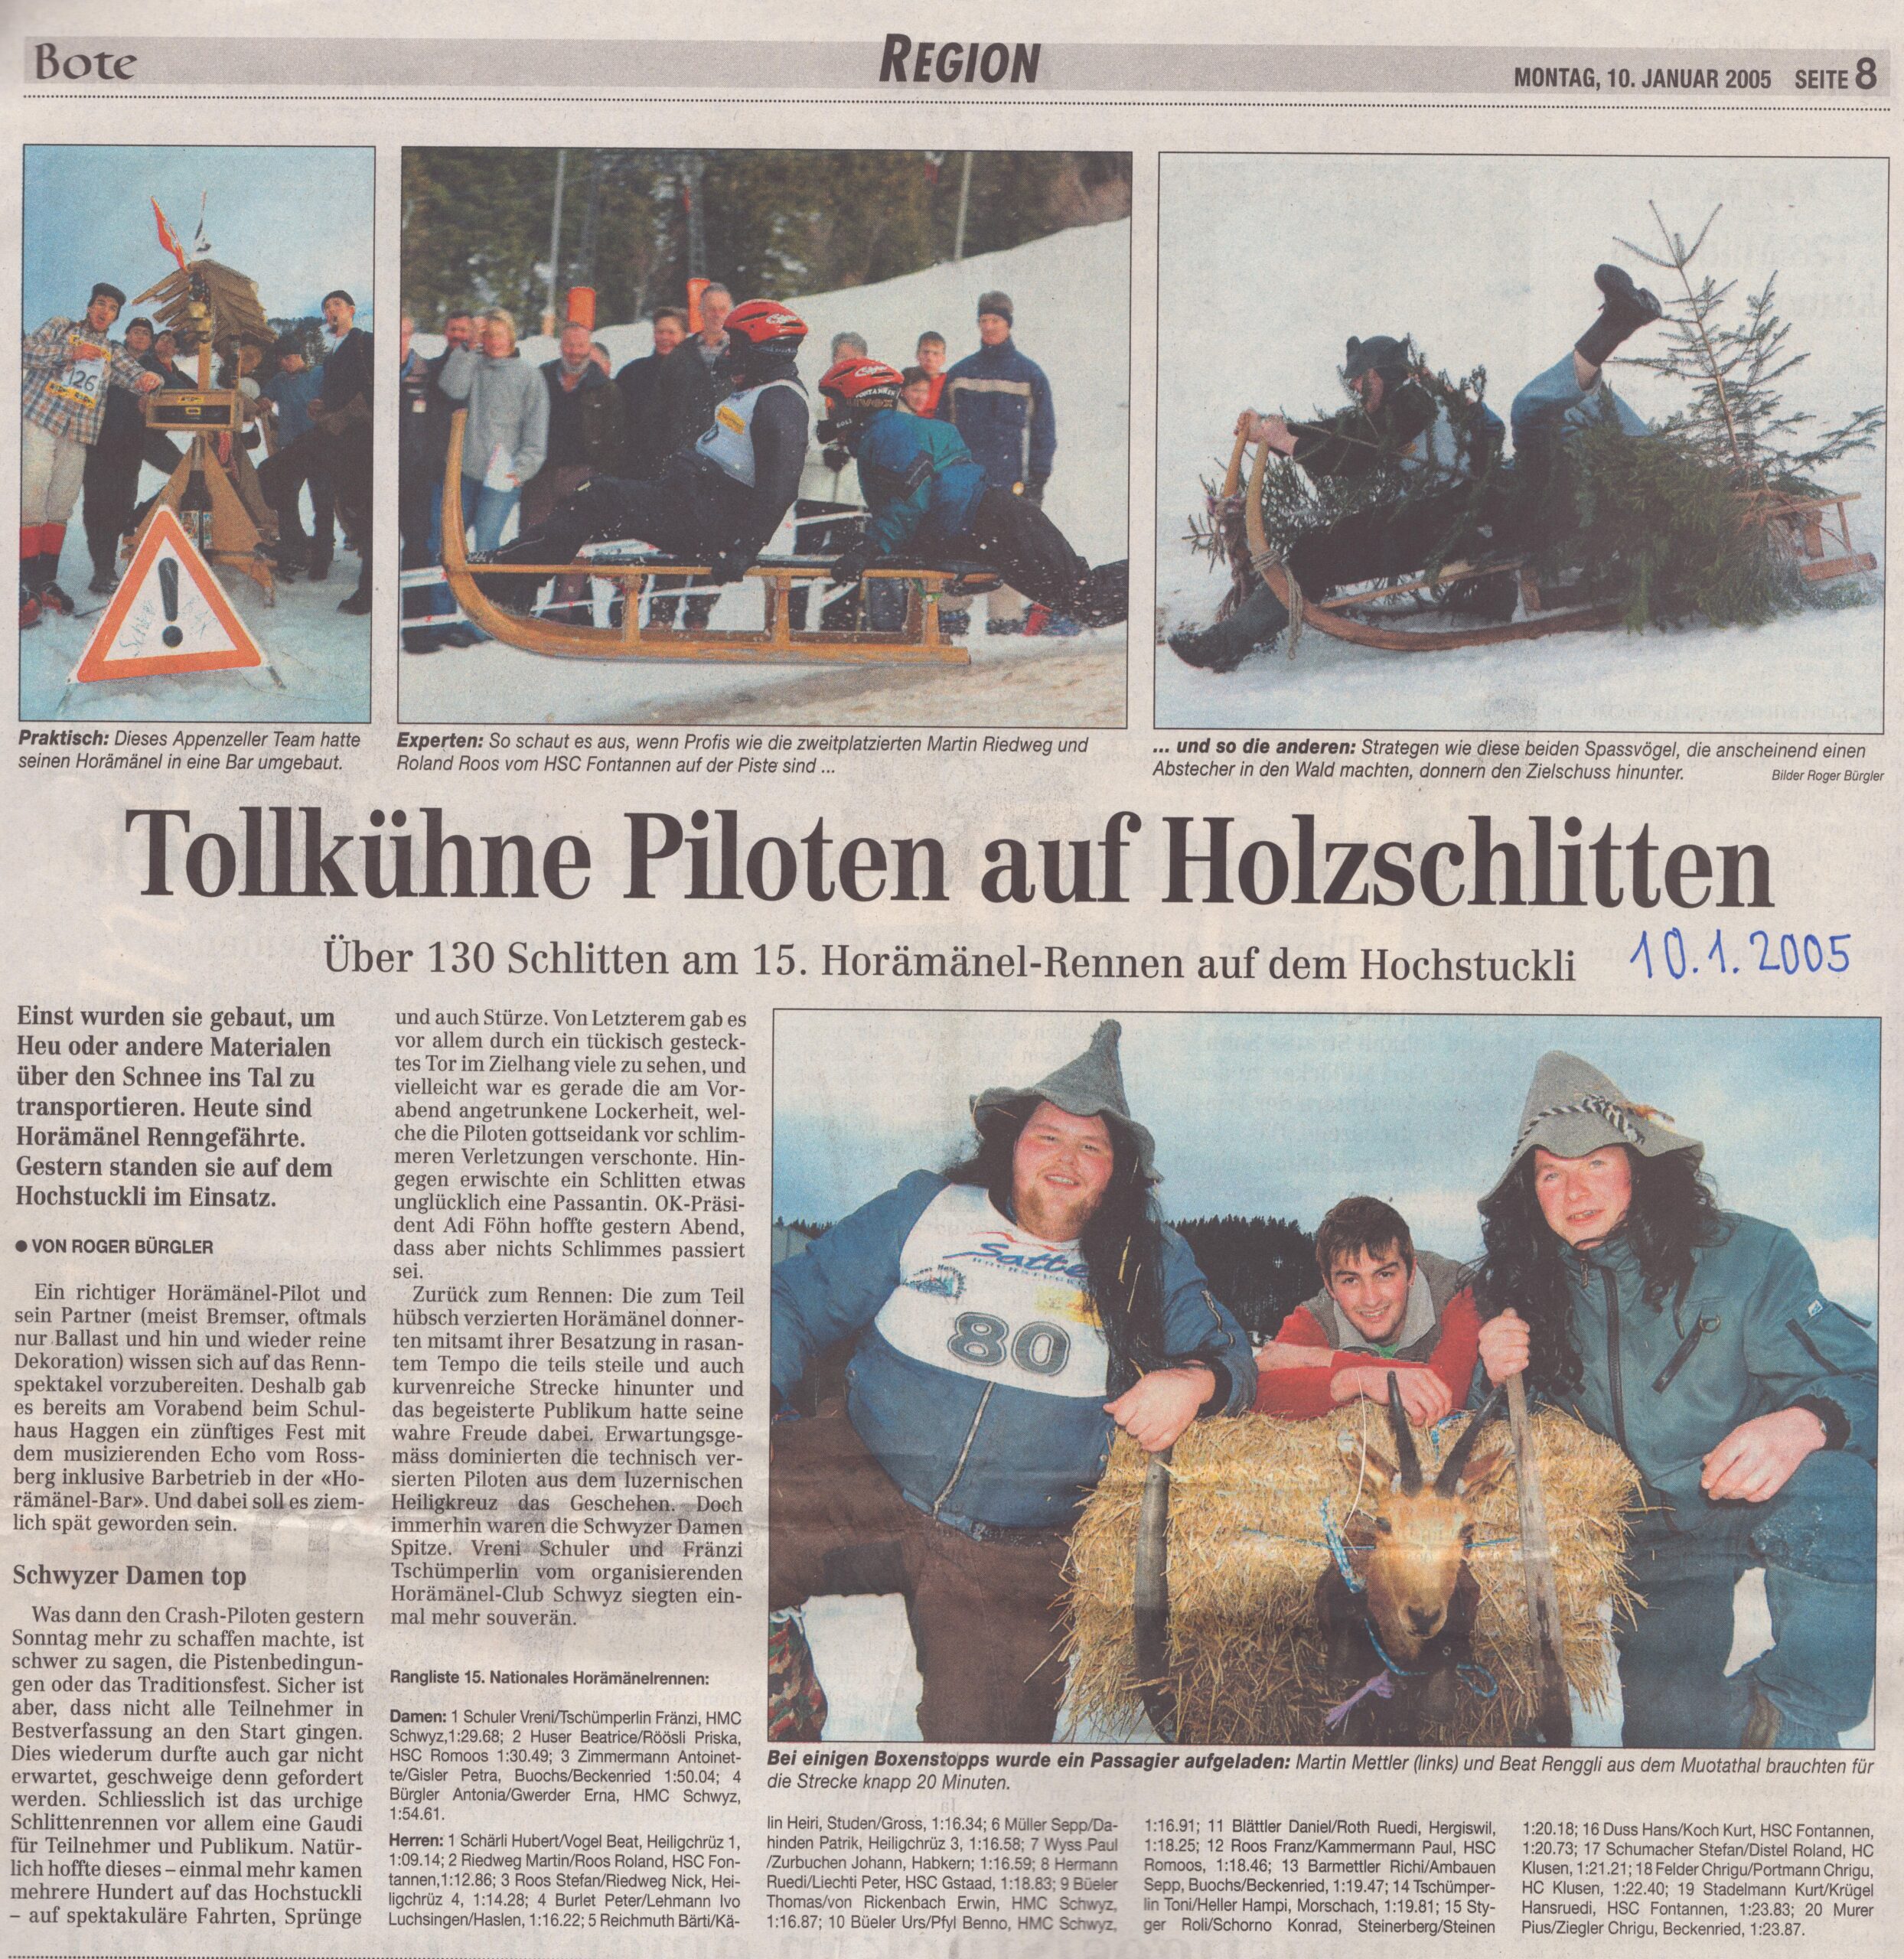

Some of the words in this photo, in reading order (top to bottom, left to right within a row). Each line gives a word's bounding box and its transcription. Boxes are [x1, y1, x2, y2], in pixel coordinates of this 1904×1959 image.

[35, 43, 138, 80] Bote
[879, 34, 1042, 83] REGION
[1515, 67, 1600, 91] MONTAG,
[1608, 69, 1635, 87] 10.
[1642, 69, 1718, 88] JANUAR
[1726, 70, 1771, 89] 2005
[1795, 70, 1848, 89] SEITE
[1856, 57, 1876, 90] 8
[69, 367, 98, 391] 126
[18, 729, 109, 745] Praktisch:
[115, 730, 167, 746] Dieses
[172, 731, 268, 750] Appenzeller
[274, 732, 315, 747] Team
[321, 732, 360, 747] hatte
[397, 732, 483, 751] Experten:
[489, 732, 510, 748] So
[516, 733, 569, 748] schaut
[575, 737, 592, 748] es
[598, 737, 629, 751] aus,
[637, 738, 678, 749] wenn
[684, 734, 729, 749] Profis
[736, 735, 762, 750] wie
[768, 735, 792, 750] die
[797, 735, 921, 754] zweitplatzierten
[928, 735, 976, 751] Martin
[983, 736, 1052, 756] Riedweg
[1058, 737, 1089, 752] und
[1177, 738, 1211, 753] und
[1216, 742, 1236, 753] so
[1243, 738, 1270, 754] die
[1276, 738, 1355, 754] anderen:
[1362, 738, 1439, 758] Strategen
[1446, 740, 1471, 755] wie
[1477, 740, 1519, 755] diese
[1525, 741, 1579, 756] beiden
[1585, 741, 1679, 761] Spassvögel,
[1687, 742, 1710, 757] die
[1717, 742, 1818, 758] anscheinend
[1823, 742, 1866, 758] einen
[18, 753, 70, 768] seinen
[76, 753, 162, 768] Horämänel
[168, 754, 181, 768] in
[187, 754, 220, 769] eine
[226, 754, 254, 769] Bar
[259, 755, 342, 774] umgebaut.
[1772, 770, 1805, 781] Bilder
[1808, 770, 1841, 784] Roger
[1844, 770, 1884, 784] Bürgler
[126, 807, 591, 900] Tollkühne
[624, 810, 950, 901] Piloten
[981, 811, 1142, 904] auf
[1162, 814, 1775, 908] Holzschlitten
[324, 934, 413, 973] Über
[429, 941, 494, 973] 130
[509, 941, 669, 974] Schlitten
[683, 952, 738, 975] am
[754, 944, 806, 975] 15.
[822, 945, 1185, 978] Horämänel-Rennen
[1198, 946, 1260, 979] auf
[1270, 947, 1347, 980] dem
[1361, 948, 1576, 981] Hochstuckli
[18, 1005, 73, 1025] Einst
[80, 1006, 165, 1025] wurden
[173, 1006, 202, 1026] sie
[210, 1006, 292, 1032] gebaut,
[301, 1012, 335, 1027] um
[396, 1008, 430, 1025] und
[435, 1009, 479, 1025] auch
[484, 1009, 547, 1025] Stürze.
[553, 1009, 588, 1025] Von
[592, 1010, 685, 1026] Letzterem
[690, 1010, 722, 1031] gab
[728, 1015, 746, 1027] es
[17, 1035, 61, 1055] Heu
[69, 1035, 119, 1055] oder
[126, 1035, 203, 1056] andere
[210, 1037, 331, 1057] Materialen
[17, 1065, 68, 1085] über
[76, 1065, 115, 1086] den
[123, 1066, 201, 1087] Schnee
[209, 1067, 240, 1087] ins
[248, 1067, 282, 1087] Tal
[290, 1073, 315, 1087] zu
[17, 1126, 140, 1146] Horämänel
[148, 1126, 305, 1152] Renngefährte.
[32, 1239, 67, 1253] VON
[72, 1239, 129, 1253] ROGER
[135, 1237, 213, 1254] BÜRGLER
[943, 1243, 1091, 1279] Satte
[35, 1283, 64, 1299] Ein
[77, 1283, 155, 1305] richtiger
[168, 1284, 320, 1301] Horämänel-Pilot
[331, 1285, 367, 1302] und
[15, 1307, 52, 1322] sein
[61, 1307, 131, 1323] Partner
[142, 1307, 197, 1325] (meist
[207, 1309, 289, 1326] Bremser,
[298, 1308, 366, 1325] oftmals
[947, 1311, 1071, 1377] 80
[14, 1564, 119, 1589] Schwyzer
[126, 1566, 204, 1585] Damen
[211, 1567, 246, 1590] top
[390, 1670, 459, 1686] Rangliste
[465, 1671, 484, 1684] 15.
[491, 1671, 569, 1684] Nationales
[573, 1671, 709, 1685] Horämänelrennen:
[390, 1710, 446, 1723] Damen:
[452, 1710, 457, 1723] 1
[464, 1710, 516, 1723] Schuler
[520, 1710, 650, 1727] Vreni/Tschümperlin
[657, 1711, 701, 1726] Fränzi,
[706, 1711, 742, 1725] HMC
[768, 1773, 791, 1788] die
[797, 1773, 857, 1788] Strecke
[863, 1774, 911, 1793] knapp
[917, 1774, 936, 1789] 20
[942, 1774, 1009, 1790] Minuten.
[11, 1813, 158, 1830] Schlittenrennen
[166, 1819, 196, 1830] vor
[204, 1814, 254, 1830] allem
[262, 1815, 300, 1831] eine
[309, 1815, 362, 1831] Gaudi
[1144, 1877, 1184, 1894] Sepp,
[1189, 1878, 1328, 1894] Buochs/Beckenried,
[1334, 1879, 1388, 1895] 1:19.47;
[1394, 1879, 1410, 1892] 14
[1413, 1879, 1495, 1896] Tschümper-
[1523, 1880, 1544, 1894] HC
[1554, 1881, 1603, 1897] Klusen,
[1614, 1882, 1668, 1897] 1:22.40;
[1678, 1882, 1694, 1895] 19
[1703, 1882, 1785, 1895] Stadelmann
[1795, 1883, 1873, 1900] Kurt/Krügel
[390, 1892, 442, 1908] ligchrüz
[452, 1892, 463, 1908] 4,
[474, 1893, 528, 1908] 1:14.28;
[538, 1893, 546, 1906] 4
[556, 1893, 595, 1907] Burlet
[605, 1893, 710, 1908] Peter/Lehmann
[721, 1895, 740, 1908] Ivo
[766, 1895, 852, 1908] Thomas/von
[865, 1895, 945, 1908] Rickenbach
[958, 1895, 999, 1912] Erwin,
[1012, 1896, 1047, 1910] HMC
[1060, 1896, 1117, 1914] Schwyz,
